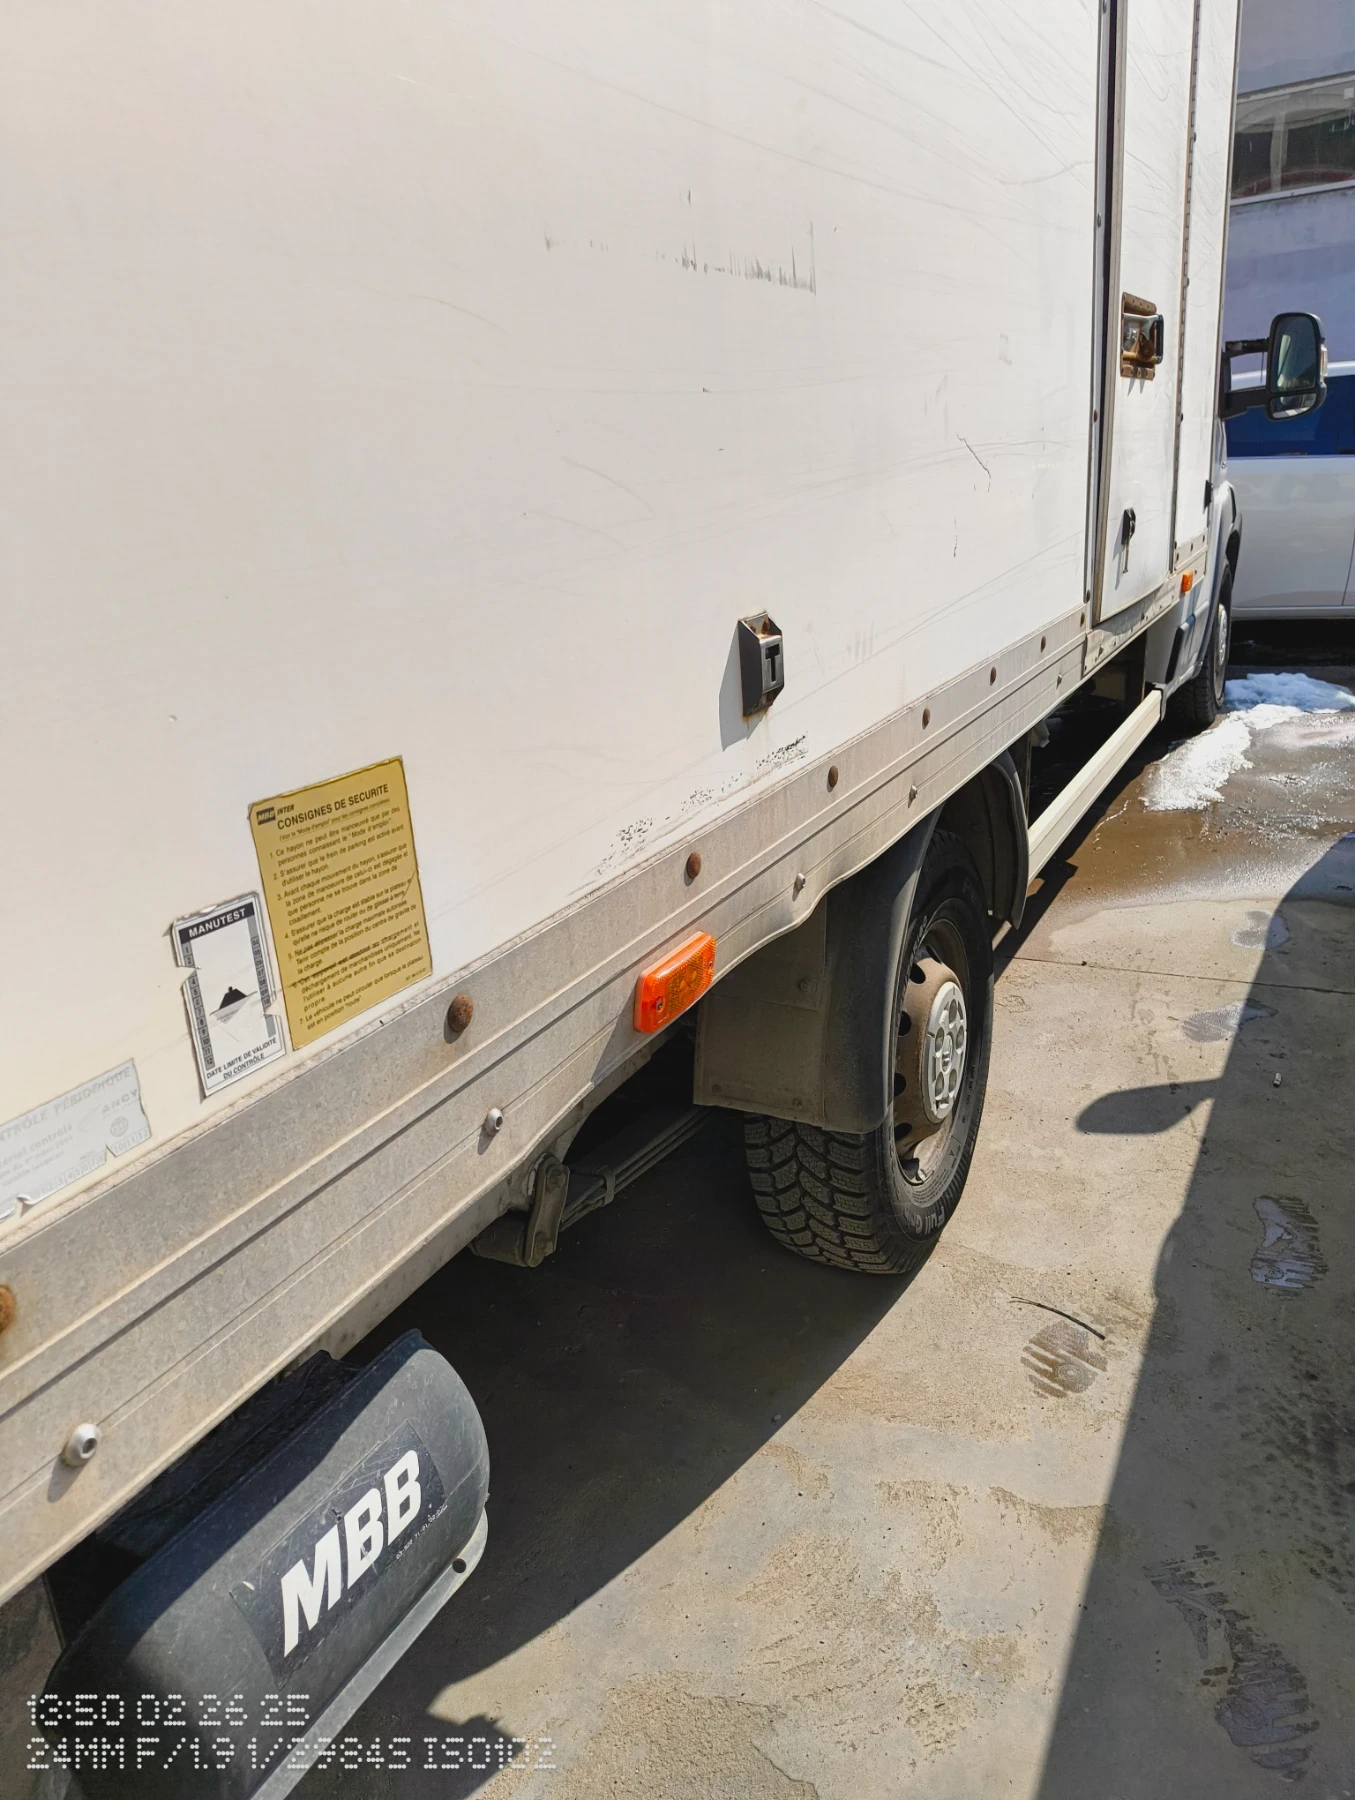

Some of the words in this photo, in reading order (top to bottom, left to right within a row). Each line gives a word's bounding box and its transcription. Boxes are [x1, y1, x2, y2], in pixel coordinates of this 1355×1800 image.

[276, 802, 333, 830] CONSIGNES
[333, 797, 346, 810] DE
[347, 783, 388, 805] SECURITE
[276, 803, 295, 815] INTER
[285, 840, 304, 855] hayon
[314, 831, 327, 844] peut
[370, 813, 380, 823] que
[381, 810, 390, 819] par
[277, 850, 307, 867] personnes
[308, 835, 340, 854] connaissant
[279, 860, 306, 877] S'assurer
[307, 857, 318, 868] que
[325, 848, 338, 859] frein
[346, 837, 366, 852] parking
[367, 833, 375, 843] est
[390, 822, 403, 833] avant
[283, 885, 299, 898] Avant
[299, 876, 320, 893] chaque
[320, 863, 351, 882] mouvement
[397, 842, 407, 852] que
[292, 894, 305, 904] zone
[373, 860, 381, 869] est
[287, 907, 298, 918] que
[299, 895, 325, 913] personne
[341, 879, 358, 893] trouve
[358, 874, 371, 885] dans
[377, 867, 390, 877] zone
[188, 908, 246, 938] MANUTEST
[316, 916, 327, 926] que
[332, 903, 351, 919] charge
[351, 899, 360, 909] est
[318, 920, 335, 935] risque
[343, 909, 358, 922] rouler
[344, 918, 362, 934] charge
[362, 907, 385, 924] maximale
[295, 953, 309, 966] Tenir
[309, 943, 330, 960] compte
[343, 927, 364, 944] position
[371, 916, 387, 929] centre
[331, 972, 352, 987] aucune
[353, 962, 367, 976] autre
[376, 954, 387, 965] que
[348, 946, 383, 969] marchandises
[342, 988, 355, 1002] peut
[373, 975, 384, 986] que
[306, 1018, 315, 1029] est
[323, 1003, 345, 1022] position
[206, 1066, 221, 1079] DATE
[222, 1054, 243, 1070] LIMITE
[243, 1050, 251, 1059] DE
[223, 1069, 232, 1079] DU
[232, 1051, 264, 1074] CONTRÔLE
[281, 1450, 421, 1657] MBB
